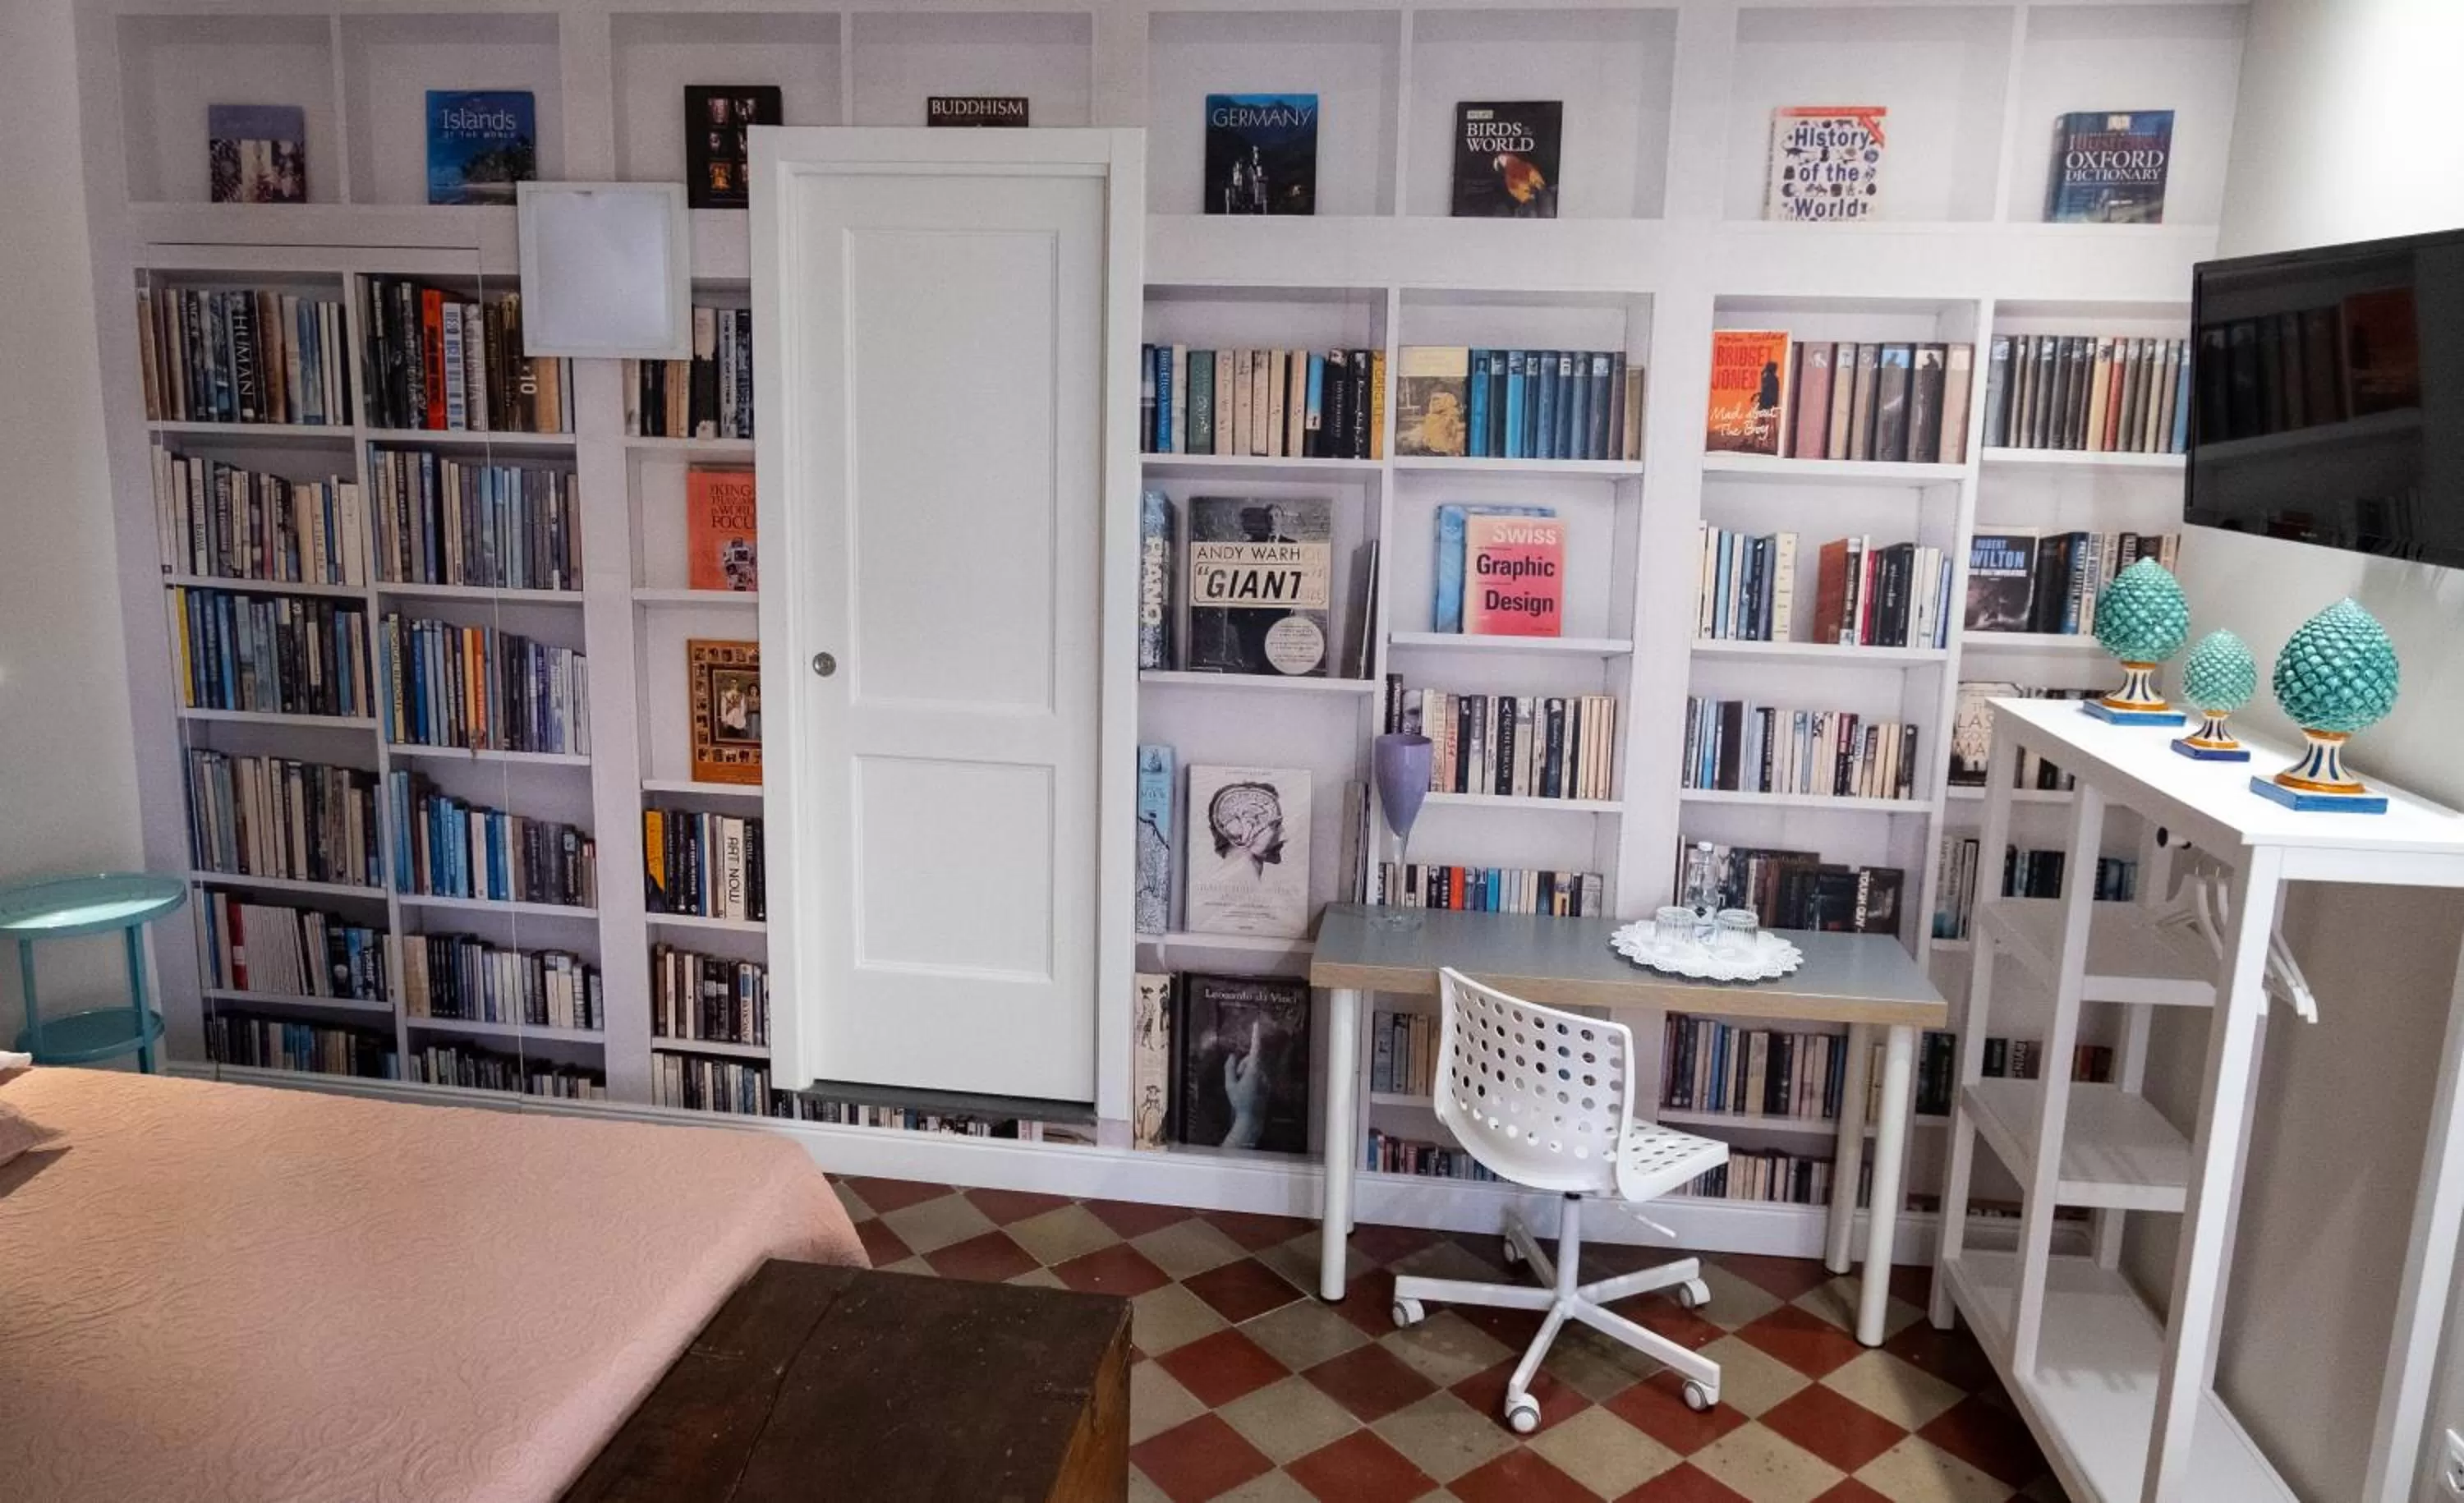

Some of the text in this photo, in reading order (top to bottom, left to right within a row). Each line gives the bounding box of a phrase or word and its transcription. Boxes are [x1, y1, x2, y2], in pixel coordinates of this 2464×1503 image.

[932, 100, 1023, 116] BUDDHISM
[1211, 107, 1313, 128] GERMANY
[442, 108, 517, 131] Islands
[1466, 122, 1523, 137] BIRDS
[1794, 127, 1871, 150] History
[1466, 137, 1534, 152] WORLD
[2066, 150, 2164, 169] OXFORD
[1799, 163, 1859, 182] of the
[2065, 168, 2162, 182] DICTIONARY
[1794, 198, 1859, 217] World
[1717, 345, 1774, 367] BRIDGET
[1712, 370, 1758, 390] JONES
[711, 515, 756, 530] FOCU
[1492, 522, 1557, 545] Swiss
[1197, 546, 1322, 561] ANDY WARH
[1970, 549, 2025, 569] WILTON
[1475, 554, 1556, 581] Graphic
[1484, 590, 1555, 618] Design
[728, 836, 741, 904] ART NOW
[1204, 988, 1299, 1003] Leonardo da Vinci
